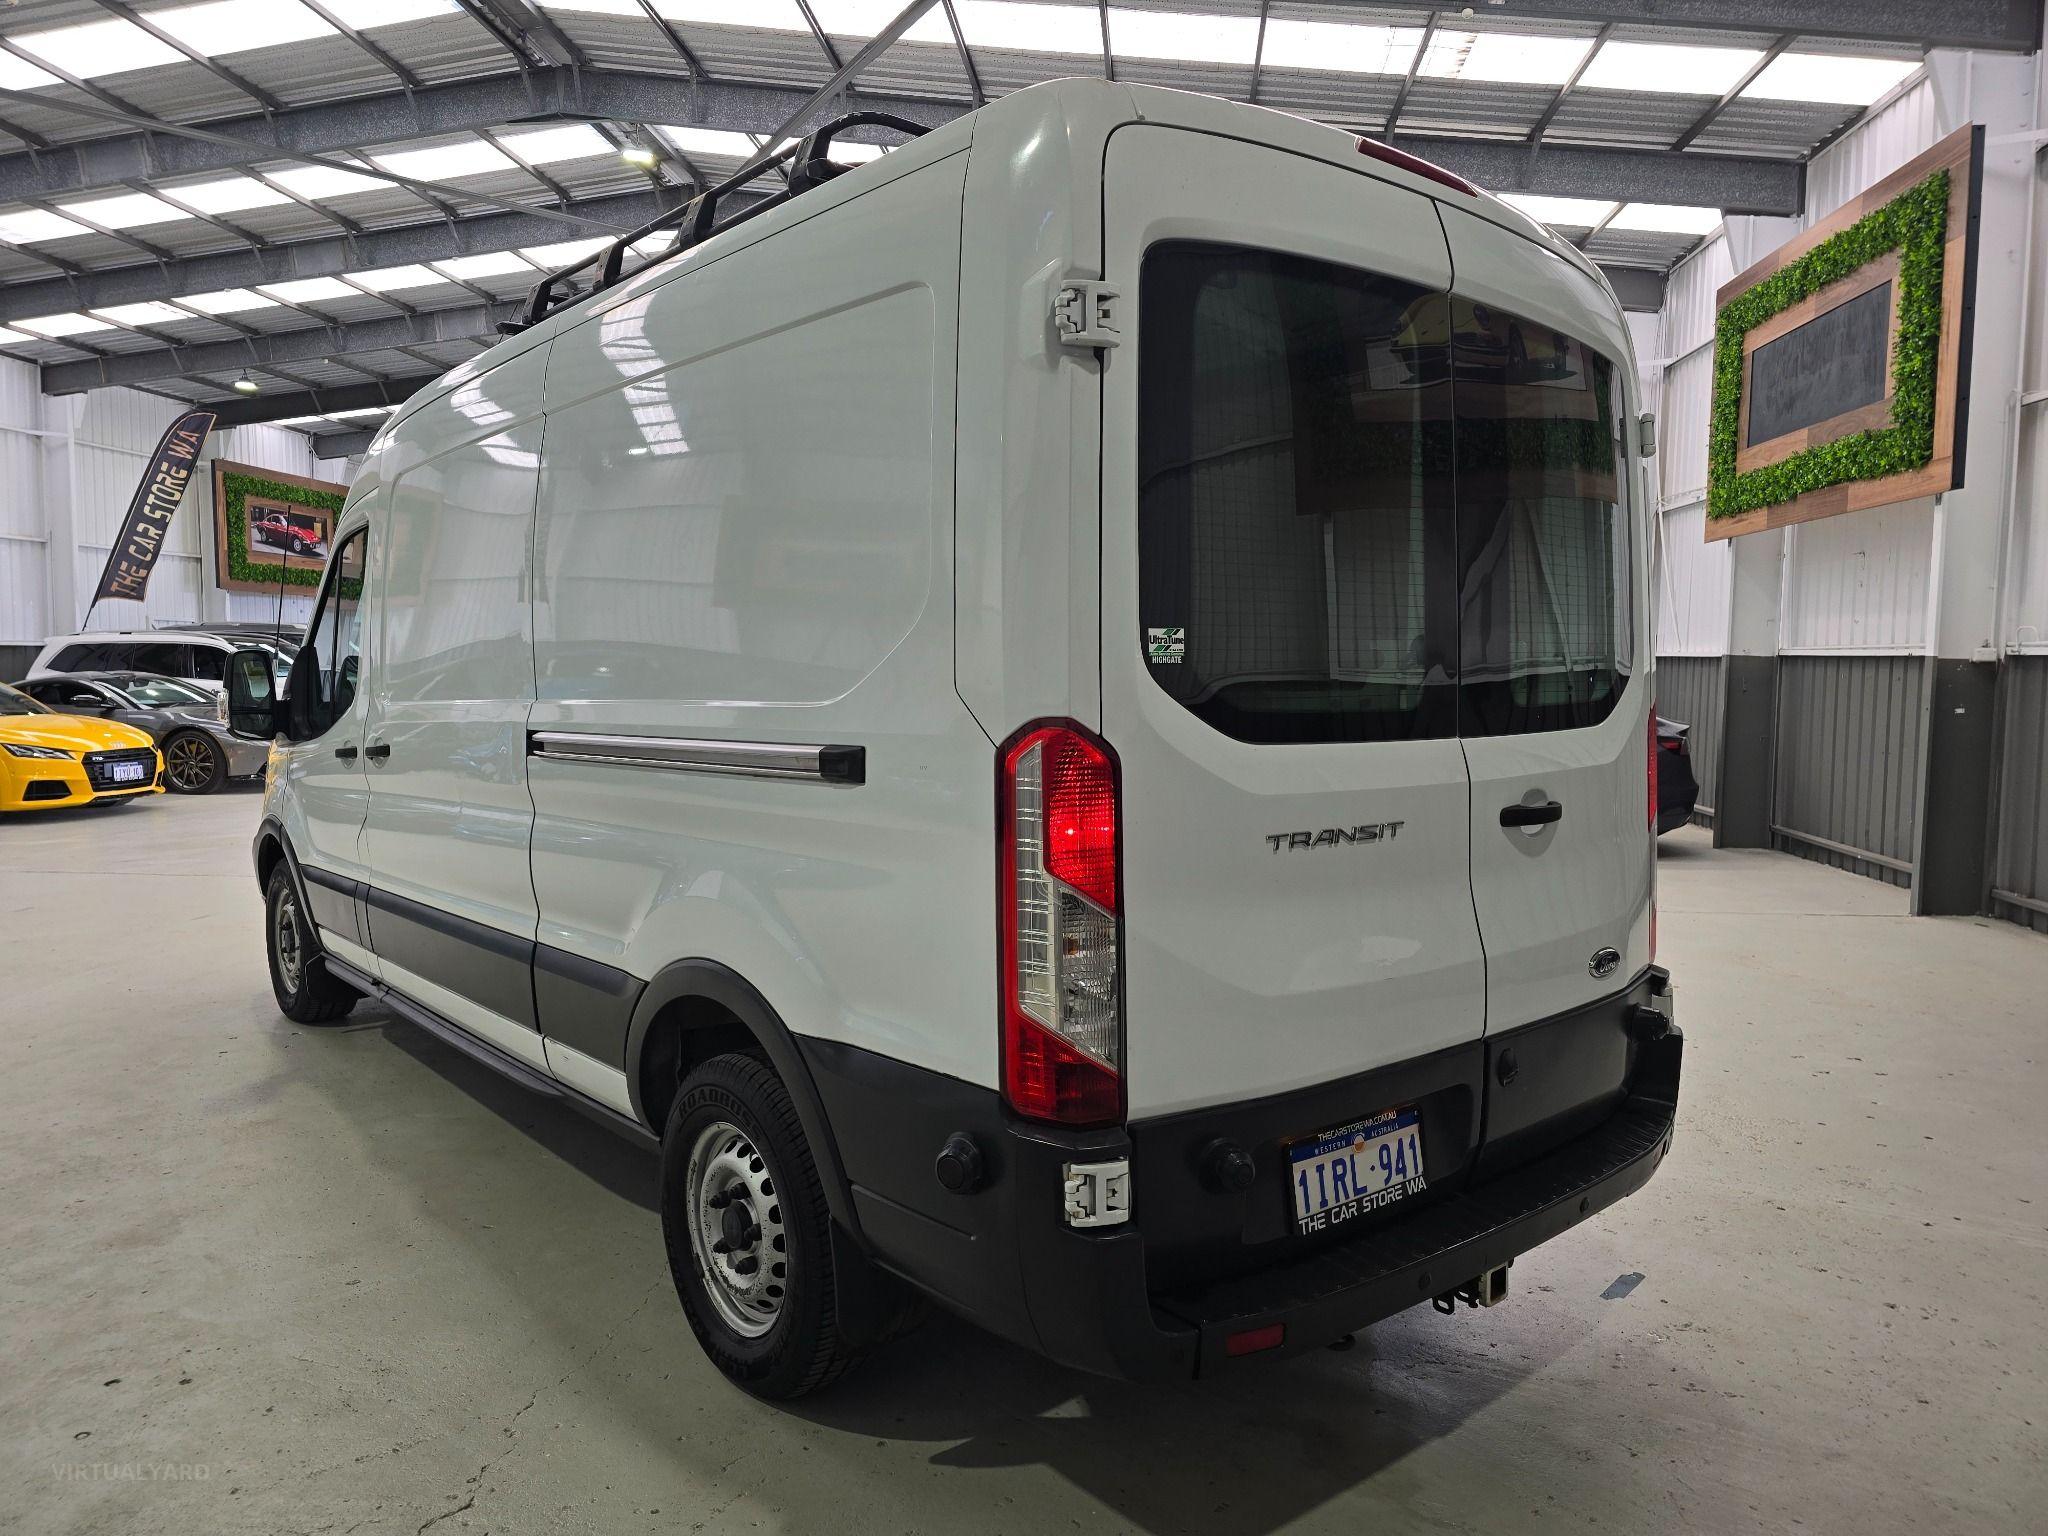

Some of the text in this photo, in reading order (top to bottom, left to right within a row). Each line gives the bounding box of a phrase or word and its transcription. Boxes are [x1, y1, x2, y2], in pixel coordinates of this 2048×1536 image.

[110, 430, 201, 596] THE CAR STORE WA
[1152, 656, 1182, 664] HIGHGATE
[1265, 820, 1405, 854] TRANSIT
[1299, 1175, 1427, 1235] THE CAR STORE WA
